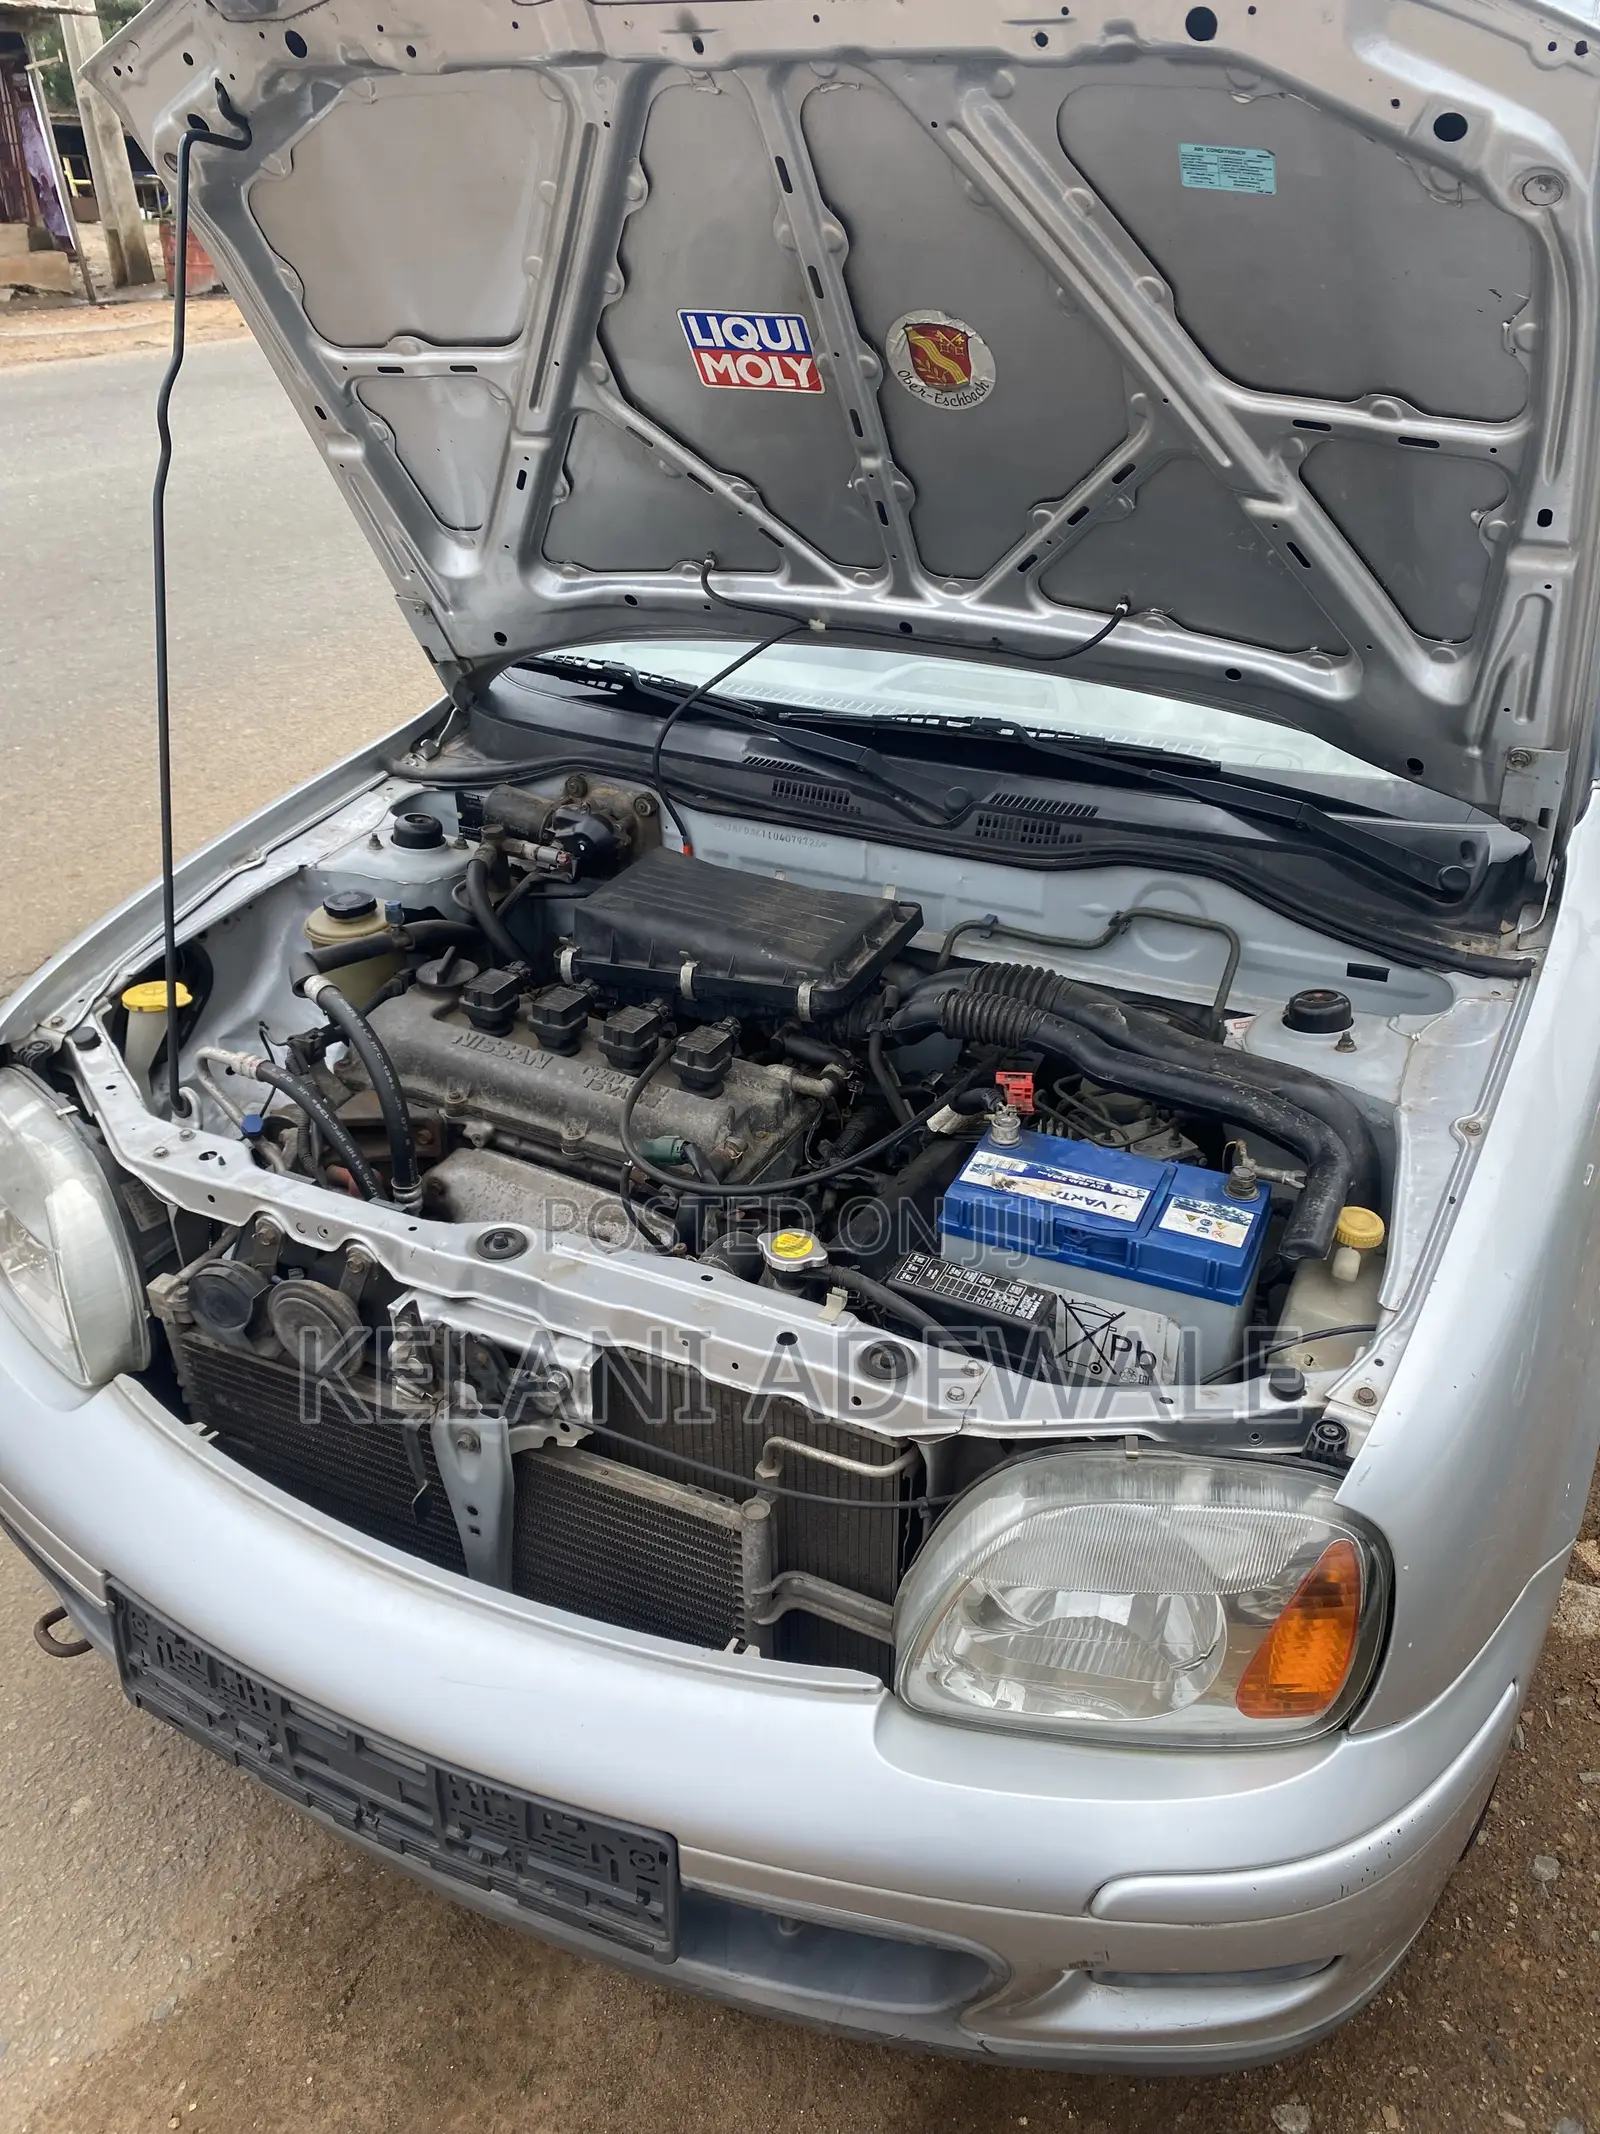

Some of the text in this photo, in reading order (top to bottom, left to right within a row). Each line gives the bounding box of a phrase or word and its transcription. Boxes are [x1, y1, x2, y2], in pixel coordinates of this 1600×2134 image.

[686, 315, 807, 352] LIQUI
[700, 352, 815, 388] MOLY
[897, 369, 990, 408] Ober-Eschbach
[452, 1032, 554, 1070] NISSAN
[1109, 1333, 1157, 1369] Pb
